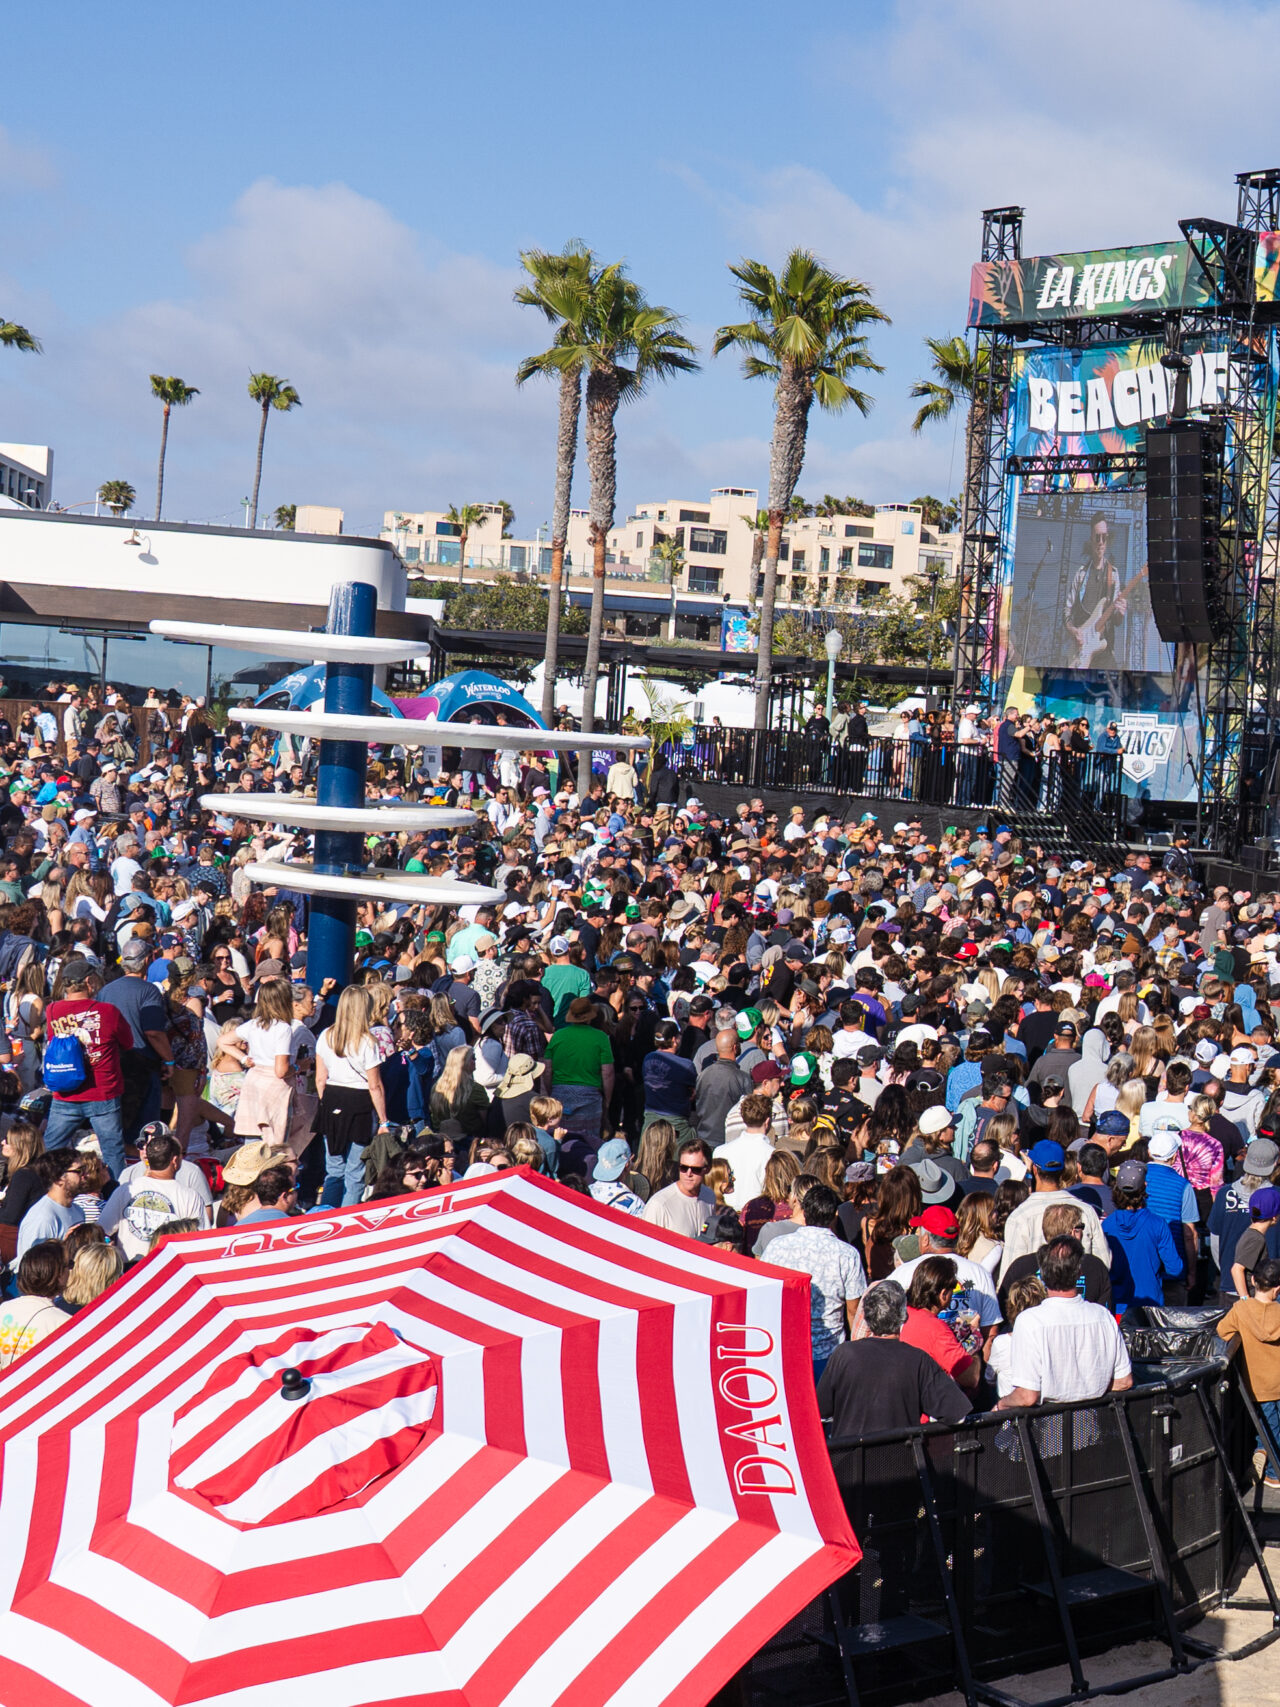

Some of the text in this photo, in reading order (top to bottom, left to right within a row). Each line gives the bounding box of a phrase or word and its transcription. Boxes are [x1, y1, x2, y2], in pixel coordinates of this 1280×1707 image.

[1037, 255, 1172, 310] LA KINGS
[461, 681, 511, 698] WATERLOO
[221, 1193, 457, 1259] DAOU
[717, 1322, 796, 1496] DAOU
